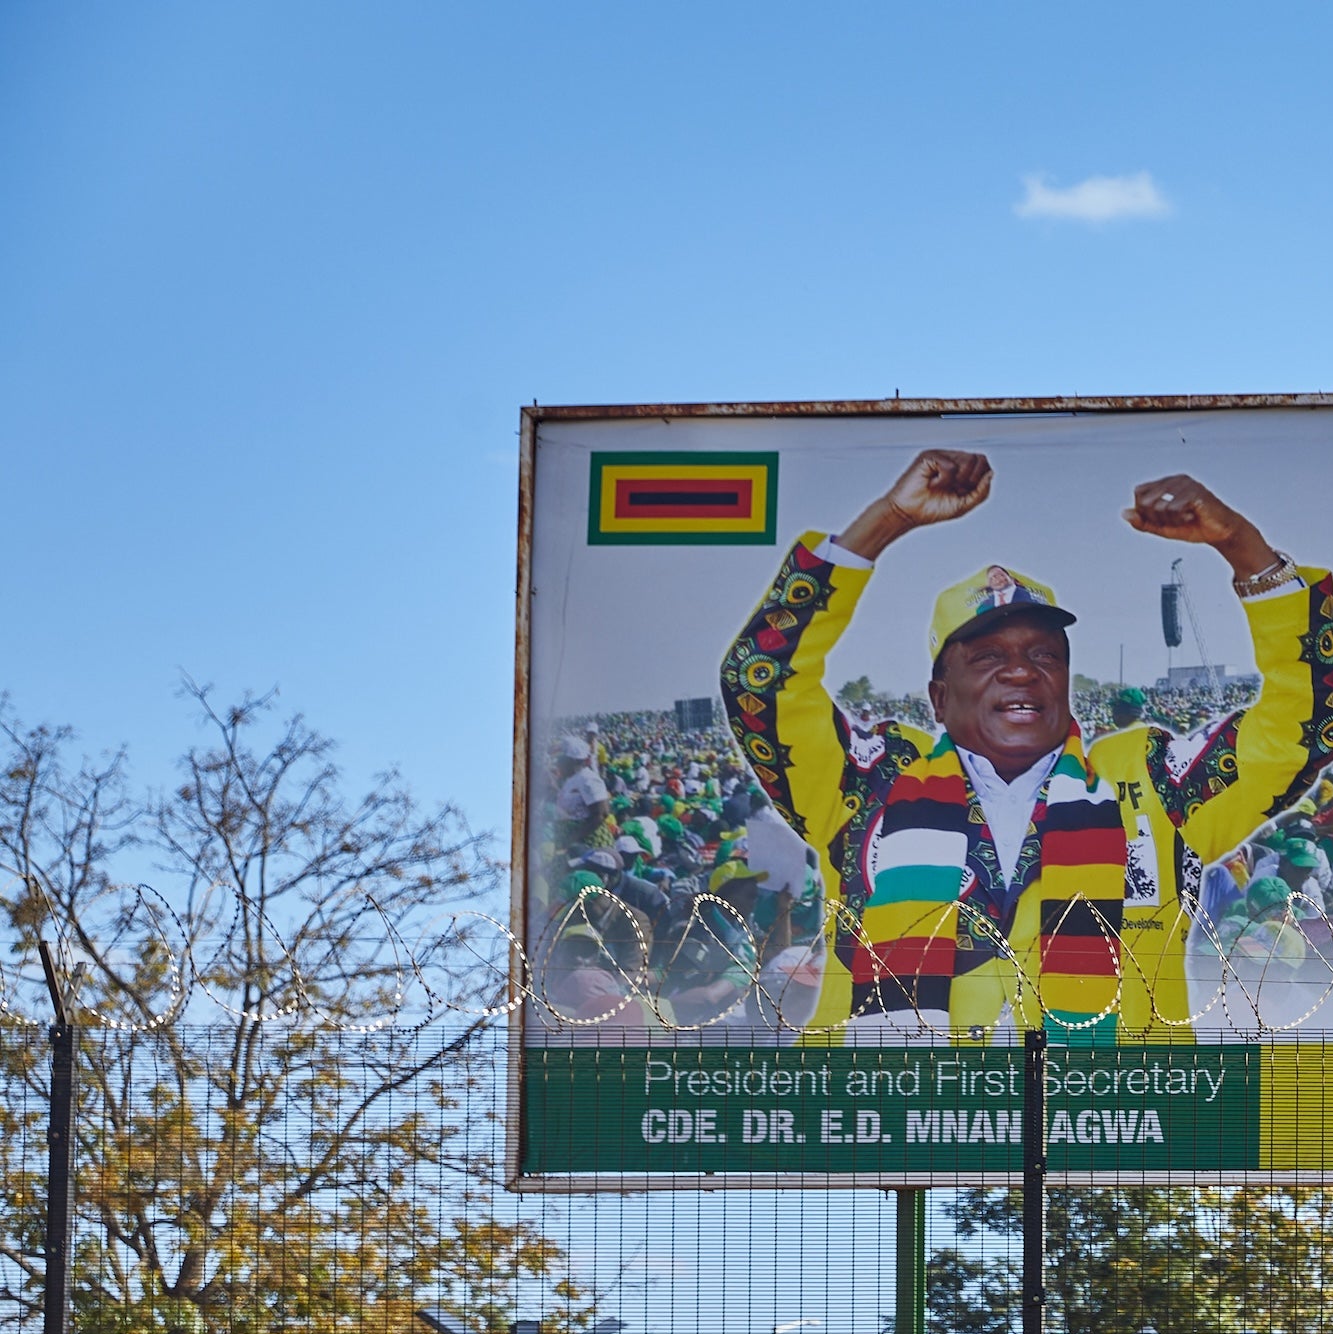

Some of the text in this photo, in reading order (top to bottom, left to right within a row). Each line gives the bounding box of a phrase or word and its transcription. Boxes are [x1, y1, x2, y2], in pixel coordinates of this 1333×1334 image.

[645, 1060, 1226, 1102] President and First Secretary
[641, 1109, 1164, 1144] CDE. DR. E.D. MNANAGWA
